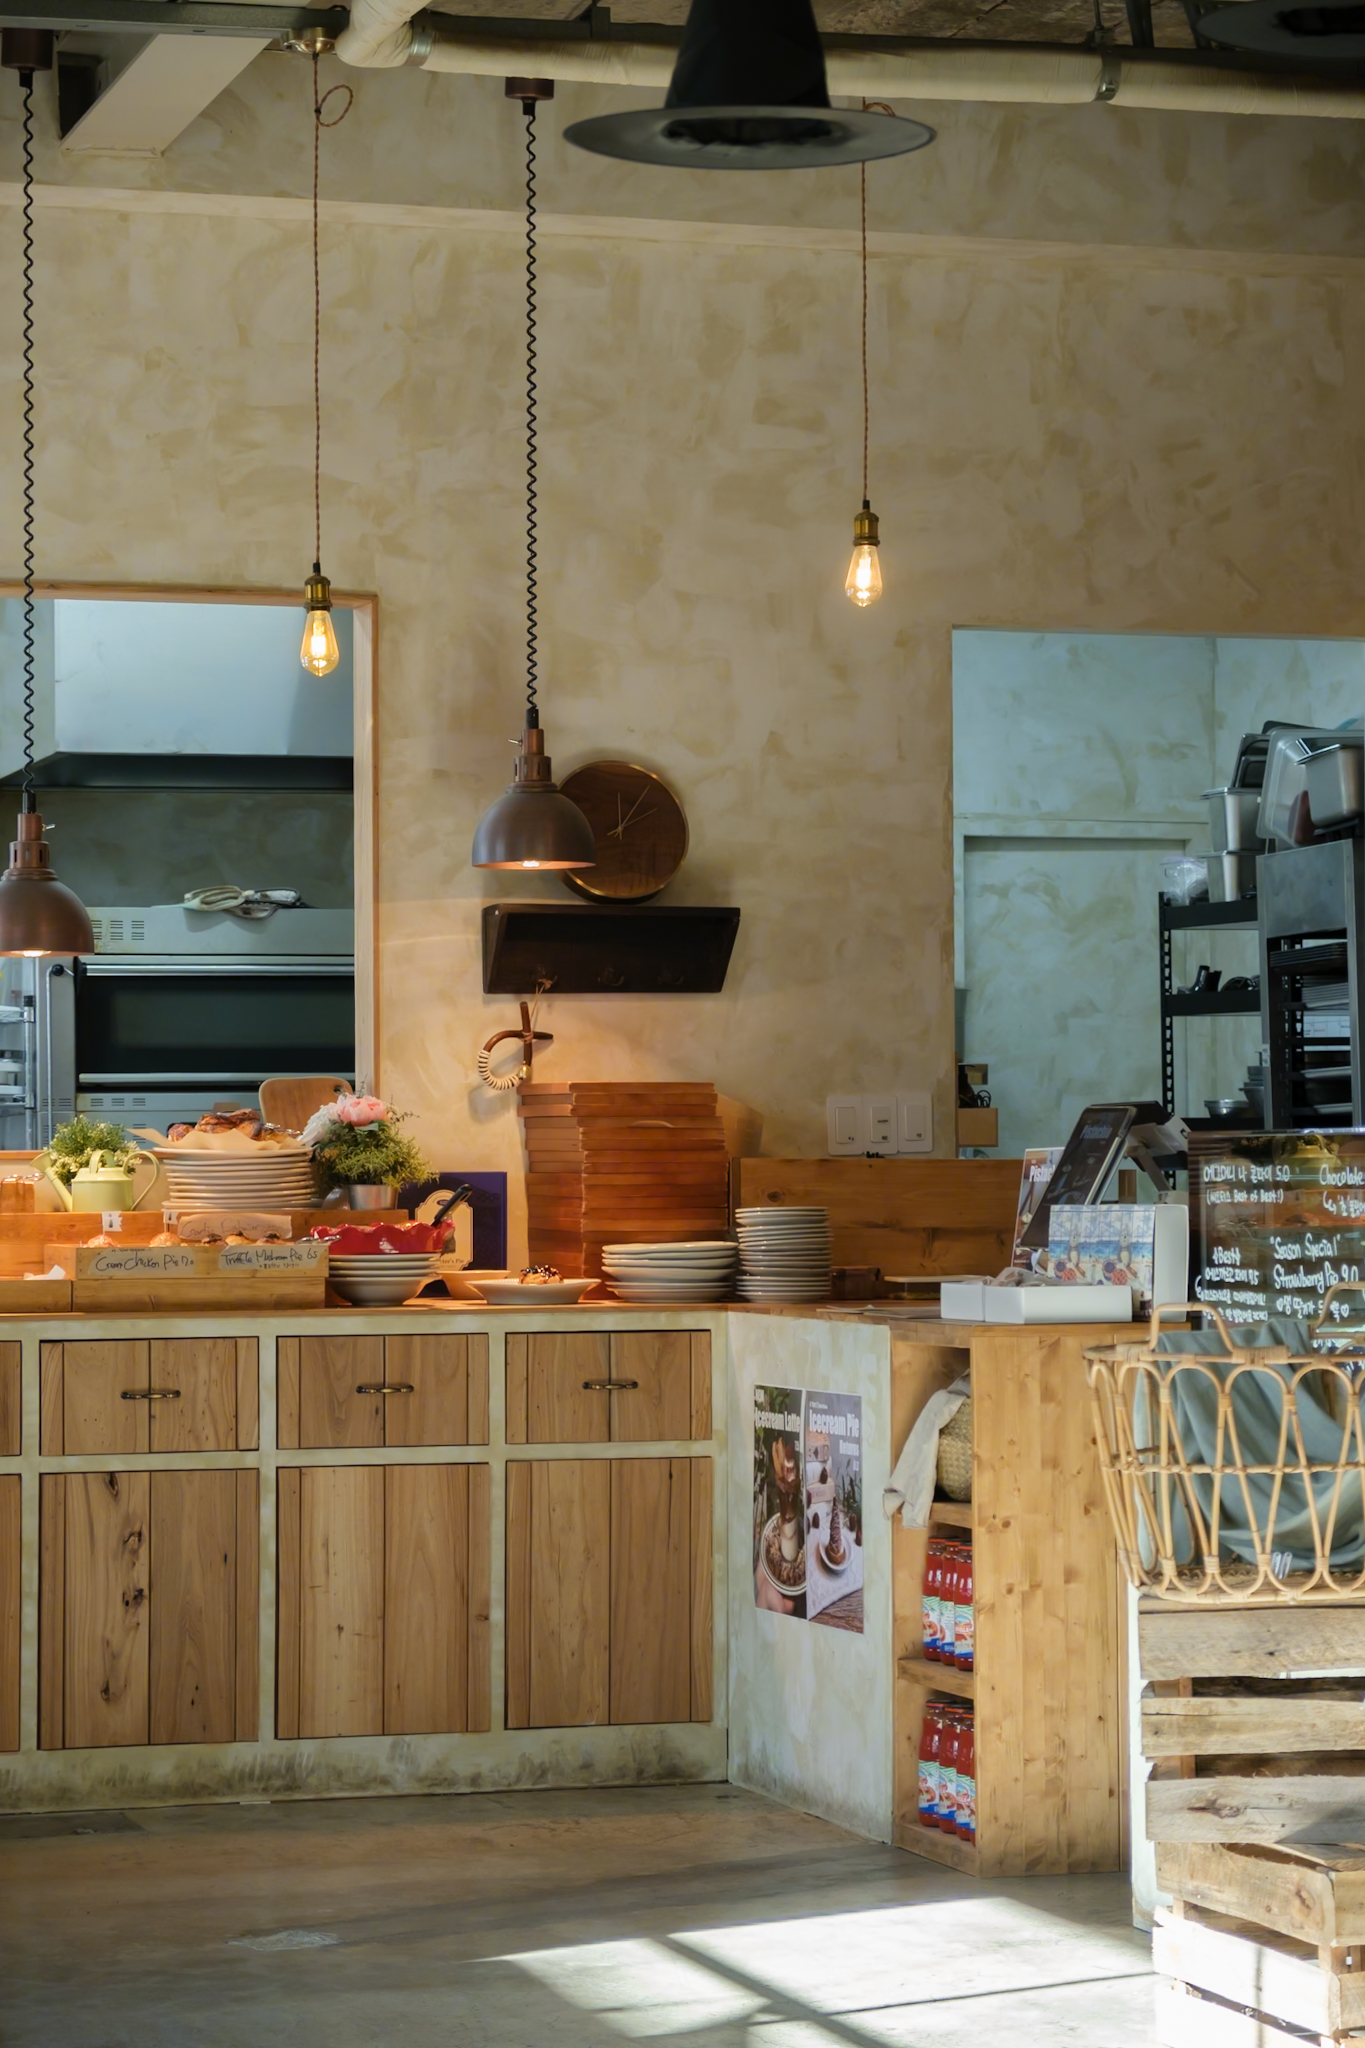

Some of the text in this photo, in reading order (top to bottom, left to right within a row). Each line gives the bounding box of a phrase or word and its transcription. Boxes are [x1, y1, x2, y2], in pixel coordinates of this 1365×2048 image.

[163, 1254, 179, 1271] Pie
[289, 1248, 303, 1262] Pie
[1273, 1263, 1325, 1294] Strawberry
[809, 1408, 860, 1438] Icecream Pie
